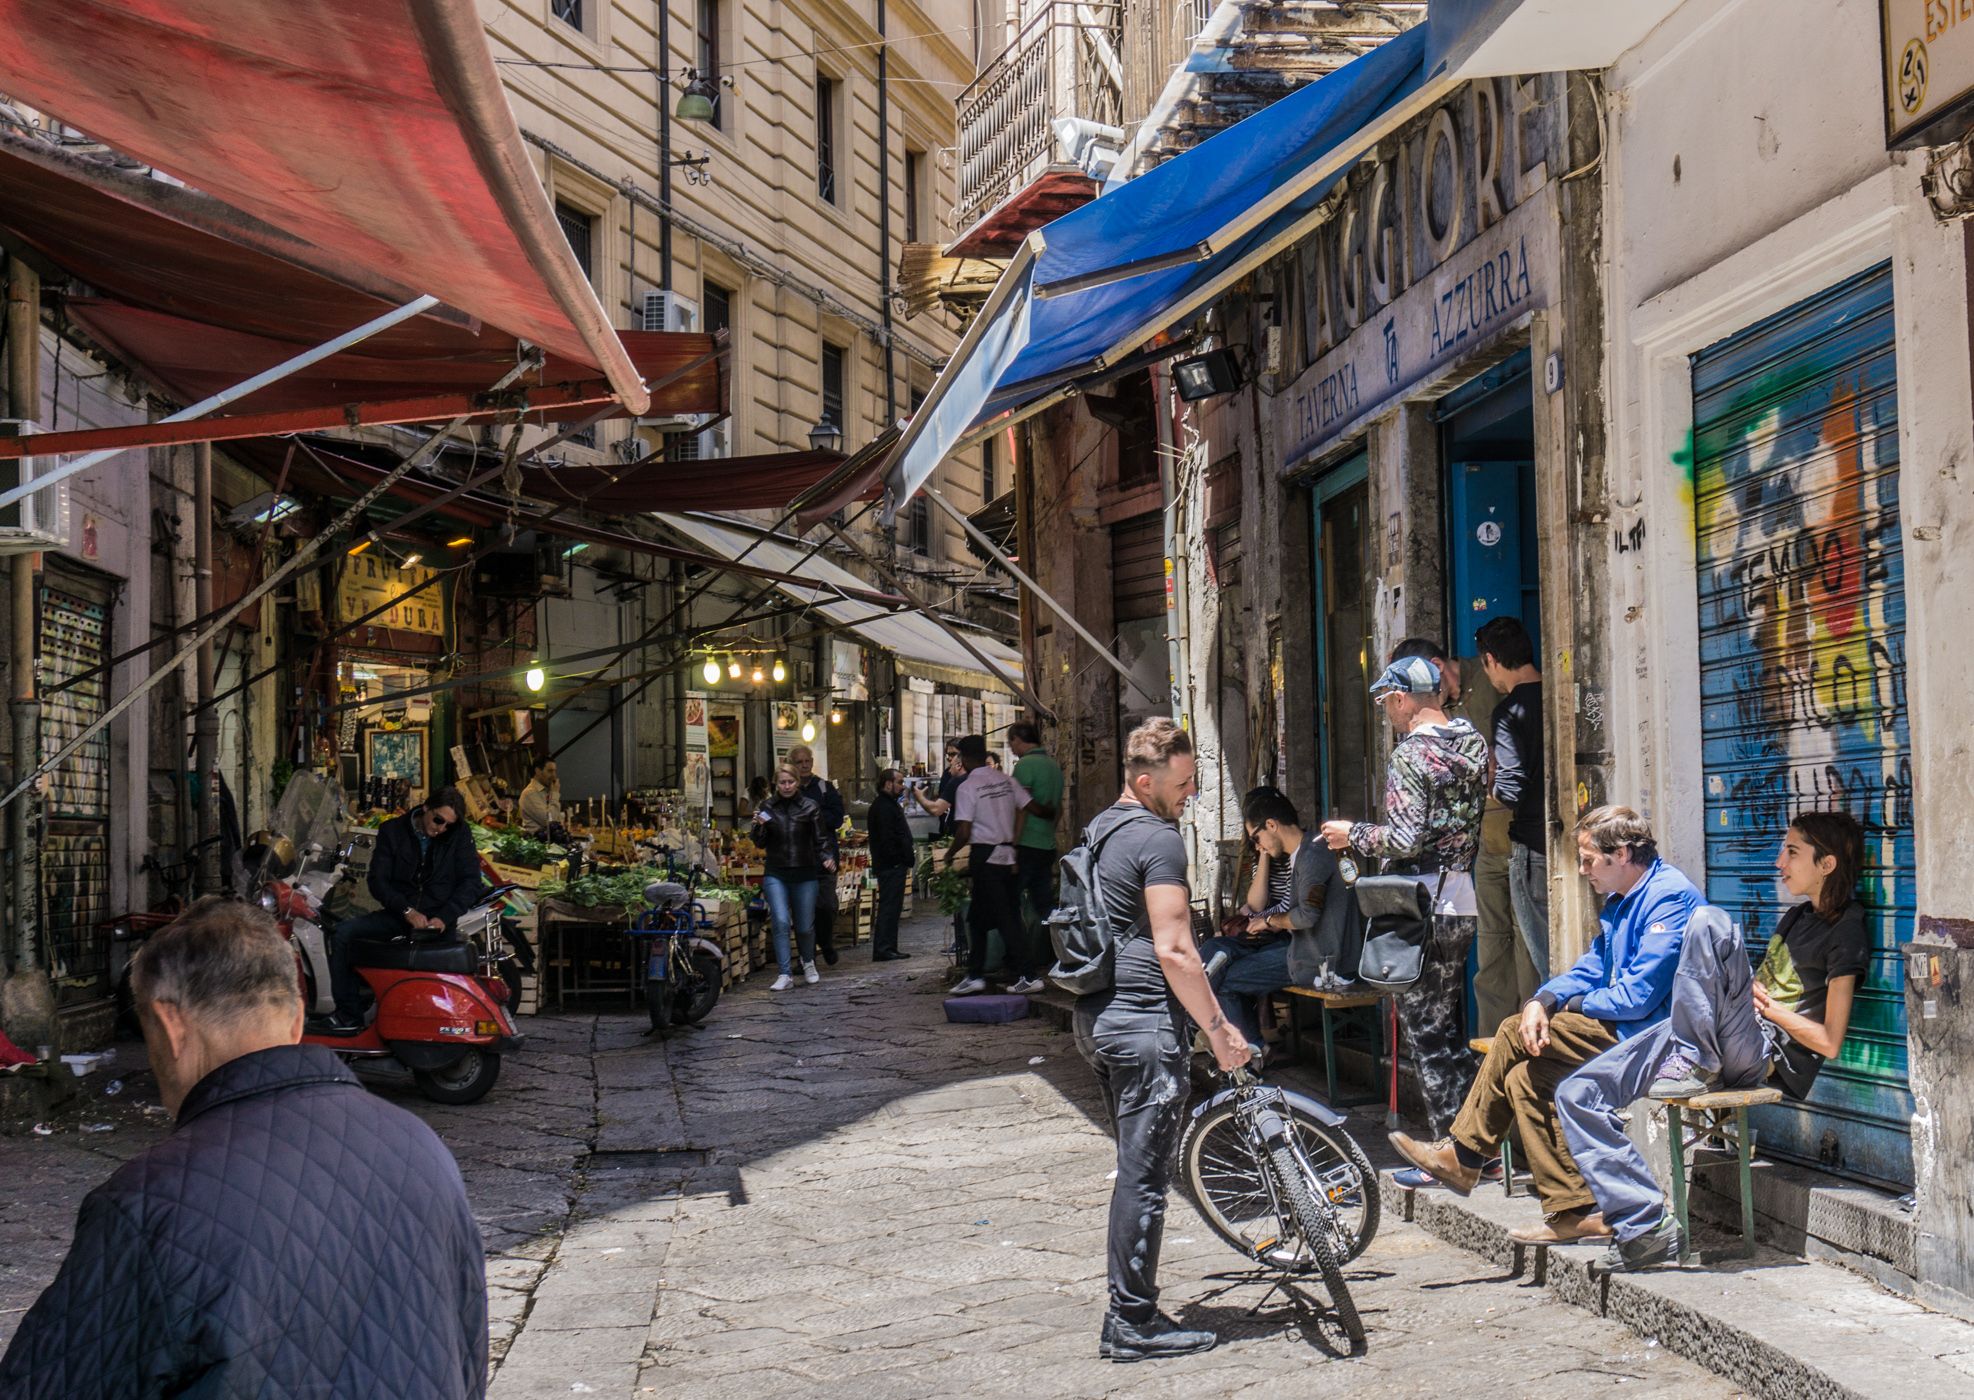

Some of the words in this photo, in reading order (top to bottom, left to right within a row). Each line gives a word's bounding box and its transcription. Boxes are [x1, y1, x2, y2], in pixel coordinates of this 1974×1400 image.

[1904, 49, 1913, 76] 2
[1297, 357, 1359, 440] TAVERNA
[1430, 235, 1531, 358] AZZURRA
[1731, 528, 1843, 620] TEMPO
[346, 596, 440, 630] VEDURA
